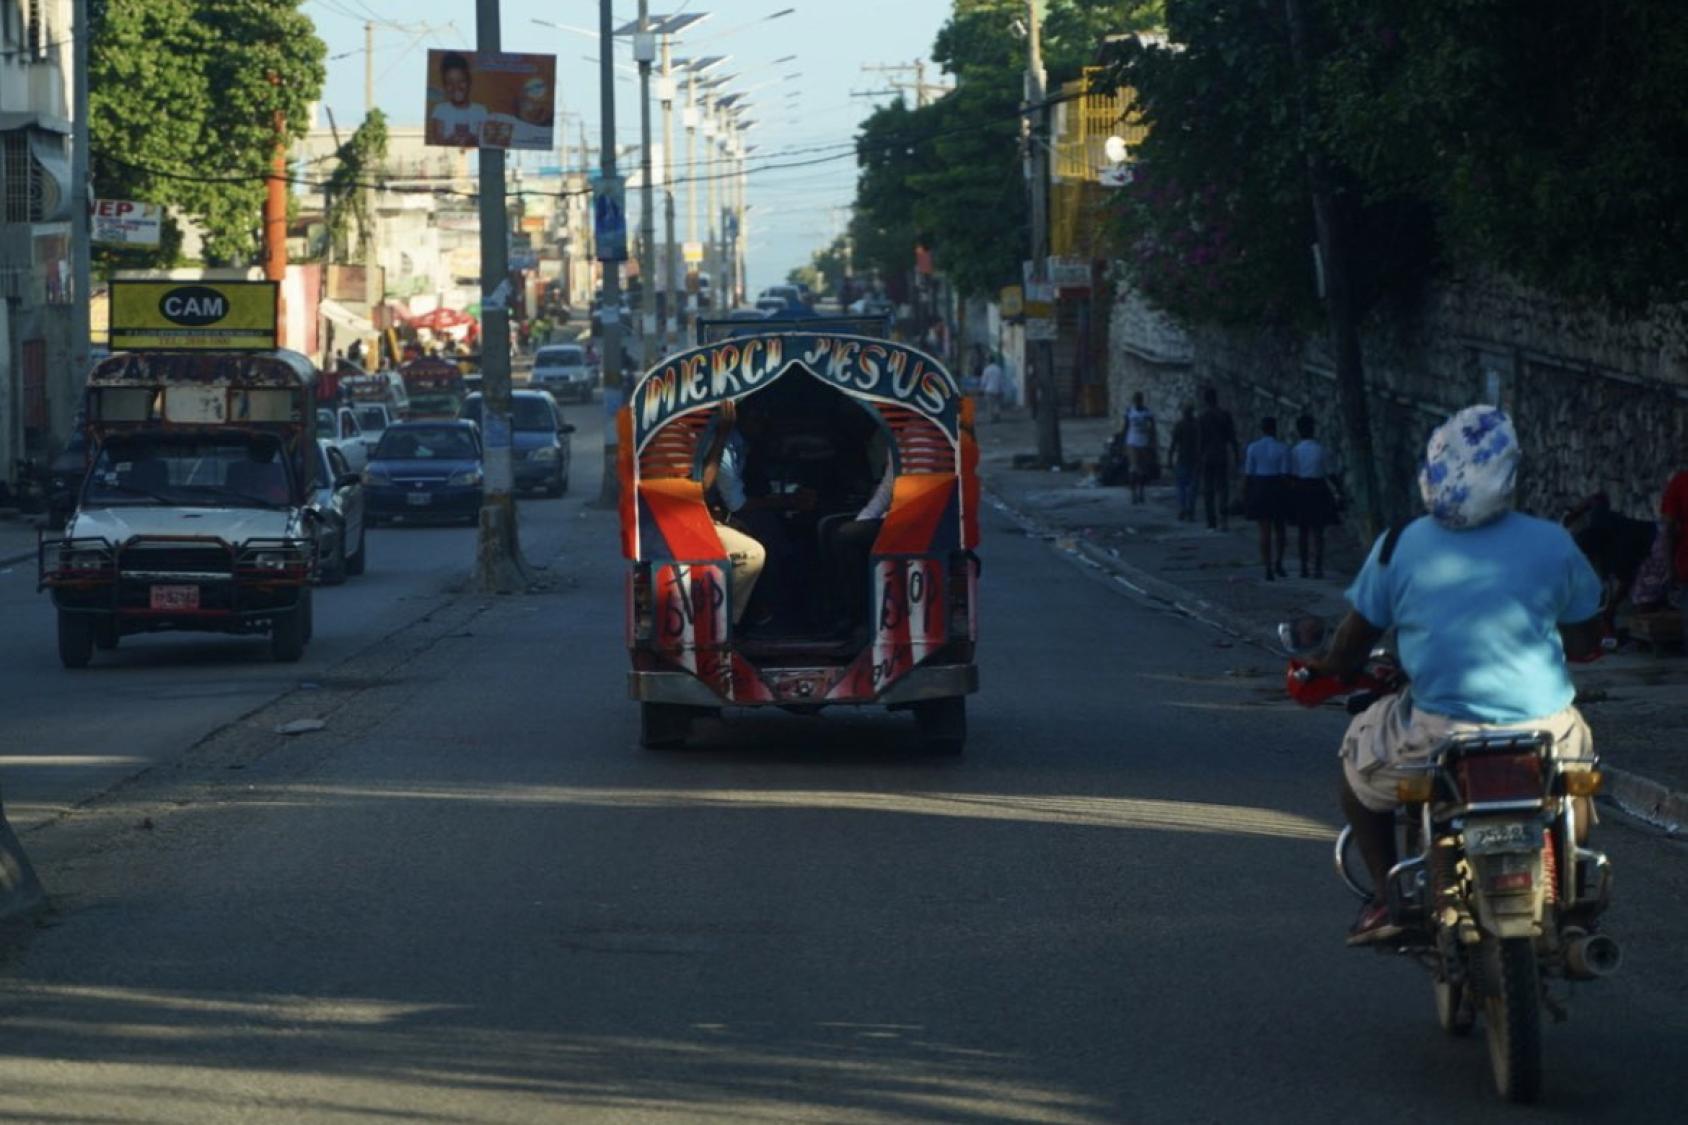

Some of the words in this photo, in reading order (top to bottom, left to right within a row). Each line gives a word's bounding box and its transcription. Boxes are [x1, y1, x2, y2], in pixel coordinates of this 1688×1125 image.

[164, 296, 223, 316] CAM
[641, 337, 782, 430] MERCI
[805, 337, 949, 414] JESUS
